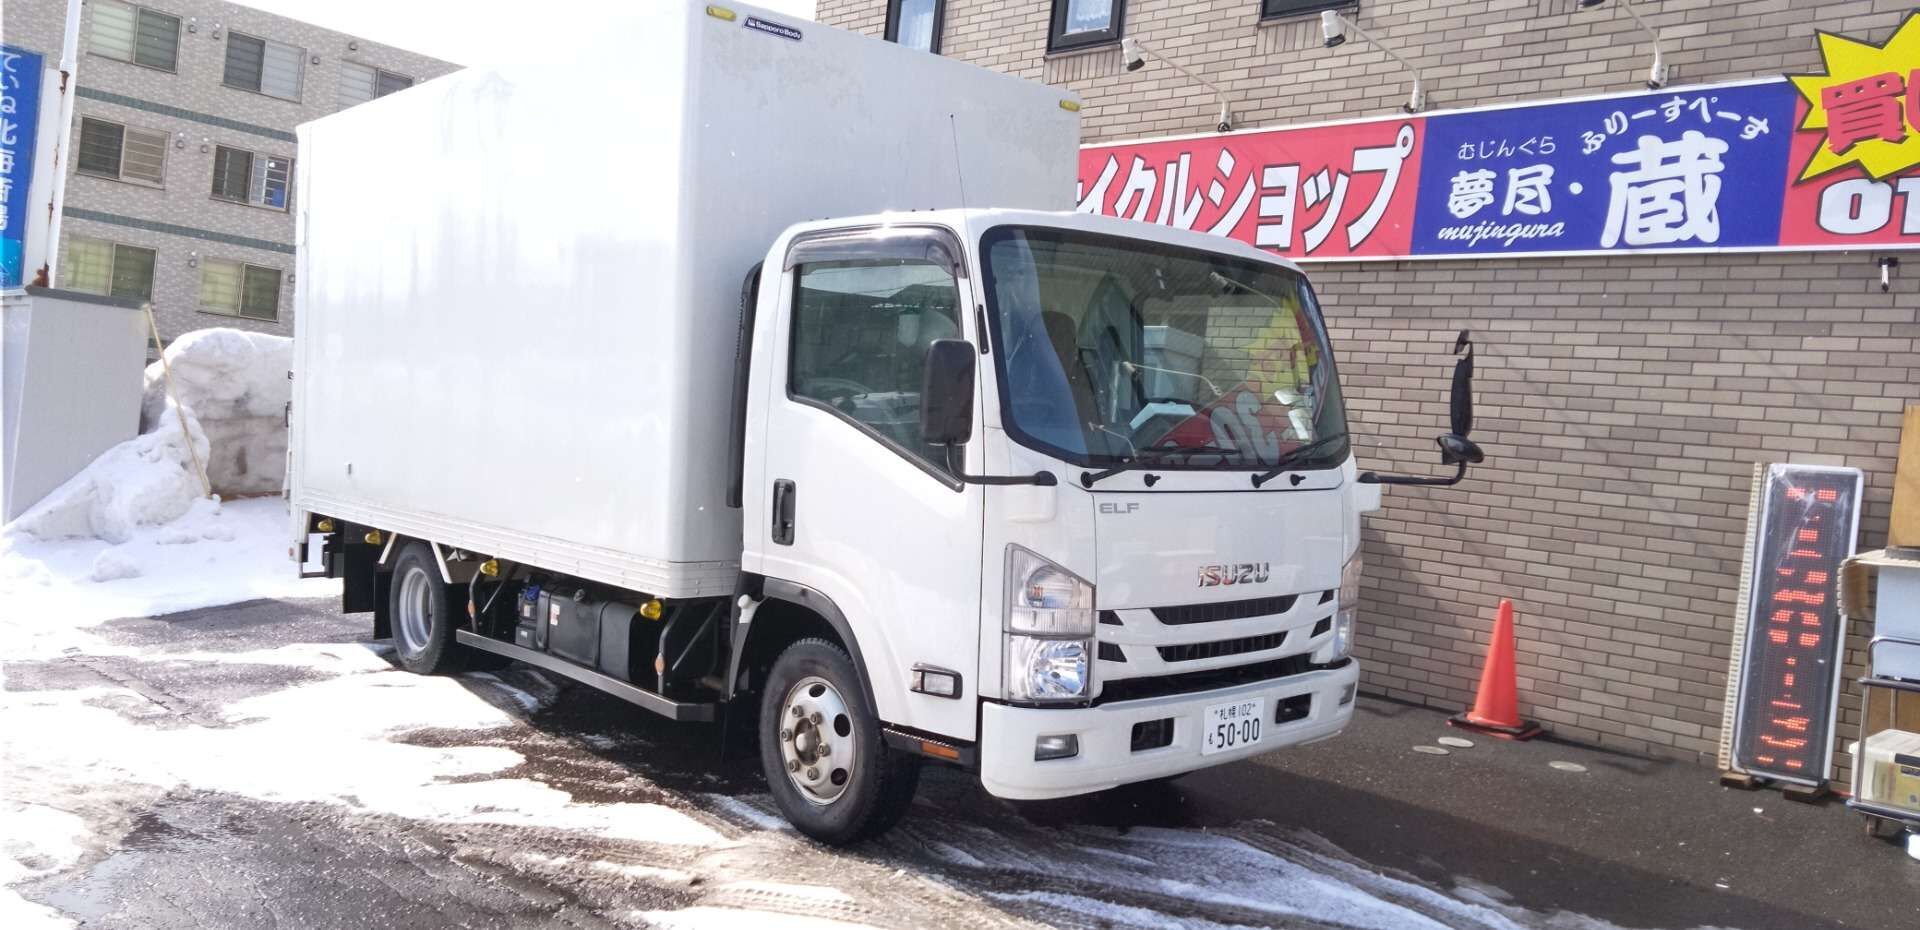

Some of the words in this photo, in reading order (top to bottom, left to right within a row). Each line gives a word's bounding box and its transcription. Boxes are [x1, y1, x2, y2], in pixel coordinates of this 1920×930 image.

[1580, 95, 1770, 155] ふりーすぺーす
[1458, 136, 1556, 160] むじんぐら
[1077, 122, 1415, 253] イクルショップ
[1438, 220, 1565, 248] mujingura
[1099, 502, 1140, 514] ELF
[1198, 562, 1270, 588] ISUZU
[1217, 717, 1260, 749] 50-00
